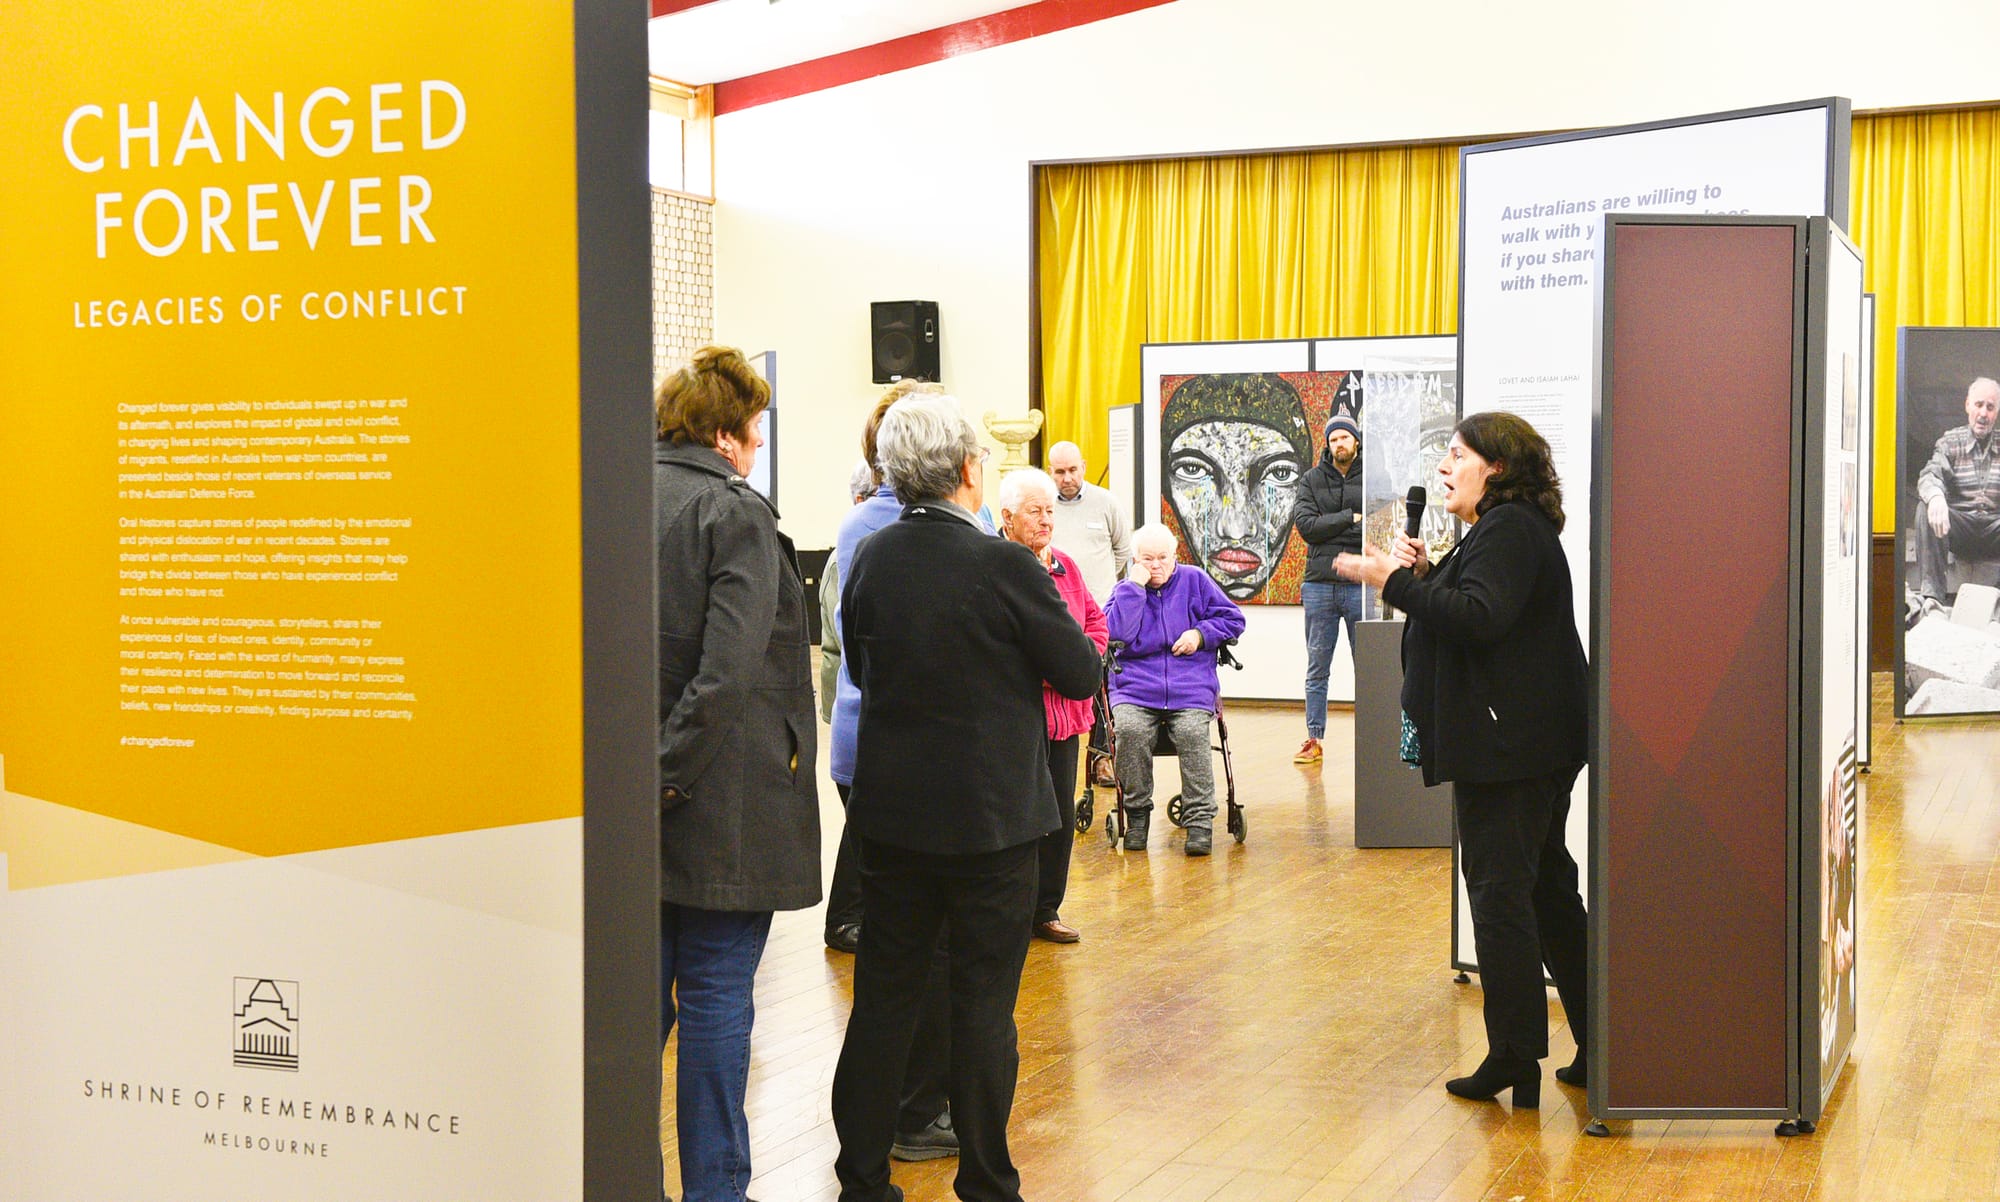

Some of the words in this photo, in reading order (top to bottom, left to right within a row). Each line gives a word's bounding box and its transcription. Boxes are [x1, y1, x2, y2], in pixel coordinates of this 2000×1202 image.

[63, 79, 467, 173] CHANGED
[1501, 198, 1597, 222] Australians
[1602, 196, 1631, 211] are
[1637, 187, 1697, 206] willing
[1703, 184, 1722, 200] to
[95, 175, 437, 259] FOREVER
[1501, 225, 1540, 245] walk
[1545, 222, 1581, 241] with
[1500, 252, 1512, 268] if
[1516, 252, 1547, 271] you
[1501, 274, 1535, 292] with
[1540, 271, 1588, 290] them.
[74, 295, 224, 328] LEGACIES
[241, 293, 283, 322] OF
[300, 286, 469, 320] CONFLICT
[1498, 376, 1519, 385] LOVET
[1520, 376, 1535, 384] AND
[116, 404, 158, 414] Changed
[158, 403, 188, 411] forever
[190, 403, 214, 413] gives
[314, 401, 342, 411] swept
[389, 400, 408, 408] and
[176, 420, 192, 428] and
[194, 420, 231, 430] explores
[234, 420, 247, 428] the
[251, 419, 280, 429] impact
[295, 419, 322, 429] global
[325, 418, 342, 426] and
[345, 418, 362, 426] civil
[128, 438, 168, 448] changing
[171, 438, 189, 446] lives
[192, 438, 209, 446] and
[212, 437, 246, 447] shaping
[360, 435, 376, 443] The
[378, 435, 411, 443] stories
[262, 455, 282, 463] from
[164, 472, 192, 480] beside
[195, 472, 219, 480] those
[234, 472, 261, 480] recent
[264, 472, 302, 480] veterans
[128, 490, 142, 498] the
[189, 490, 226, 498] Defence
[118, 519, 137, 527] Oral
[177, 519, 211, 529] capture
[213, 519, 242, 527] stories
[255, 519, 287, 529] people
[138, 537, 173, 546] physical
[265, 537, 293, 545] recent
[340, 537, 372, 545] Stories
[119, 554, 149, 562] shared
[152, 554, 168, 562] with
[224, 554, 240, 562] and
[271, 555, 304, 564] offering
[308, 555, 341, 565] insights
[345, 555, 362, 563] that
[366, 556, 384, 565] may
[386, 555, 408, 565] help
[118, 570, 146, 580] bridge
[150, 571, 162, 579] the
[166, 571, 191, 579] divide
[194, 571, 230, 579] between
[233, 572, 258, 580] those
[260, 572, 279, 580] who
[281, 572, 304, 580] have
[364, 573, 398, 581] conflict
[119, 588, 136, 596] and
[165, 589, 183, 597] who
[185, 589, 206, 597] have
[202, 618, 219, 626] and
[333, 620, 358, 628] share
[361, 620, 382, 628] their
[218, 635, 242, 644] loved
[120, 651, 144, 659] moral
[188, 652, 216, 661] Faced
[218, 653, 235, 661] with
[238, 654, 252, 662] the
[255, 654, 279, 662] worst
[340, 657, 364, 666] many
[368, 658, 404, 667] express
[119, 668, 138, 676] their
[184, 669, 201, 677] and
[305, 672, 339, 680] forward
[342, 673, 359, 681] and
[120, 685, 138, 693] their
[141, 686, 164, 696] pasts
[168, 686, 184, 694] with
[234, 688, 253, 698] They
[332, 690, 351, 698] their
[279, 707, 310, 717] finding
[312, 709, 350, 719] purpose
[352, 709, 370, 717] and
[84, 1079, 182, 1107] SHRINE
[194, 1090, 227, 1110] OF
[243, 1095, 462, 1135] REMEMBRANCE
[204, 1131, 330, 1158] MELBOURNE
